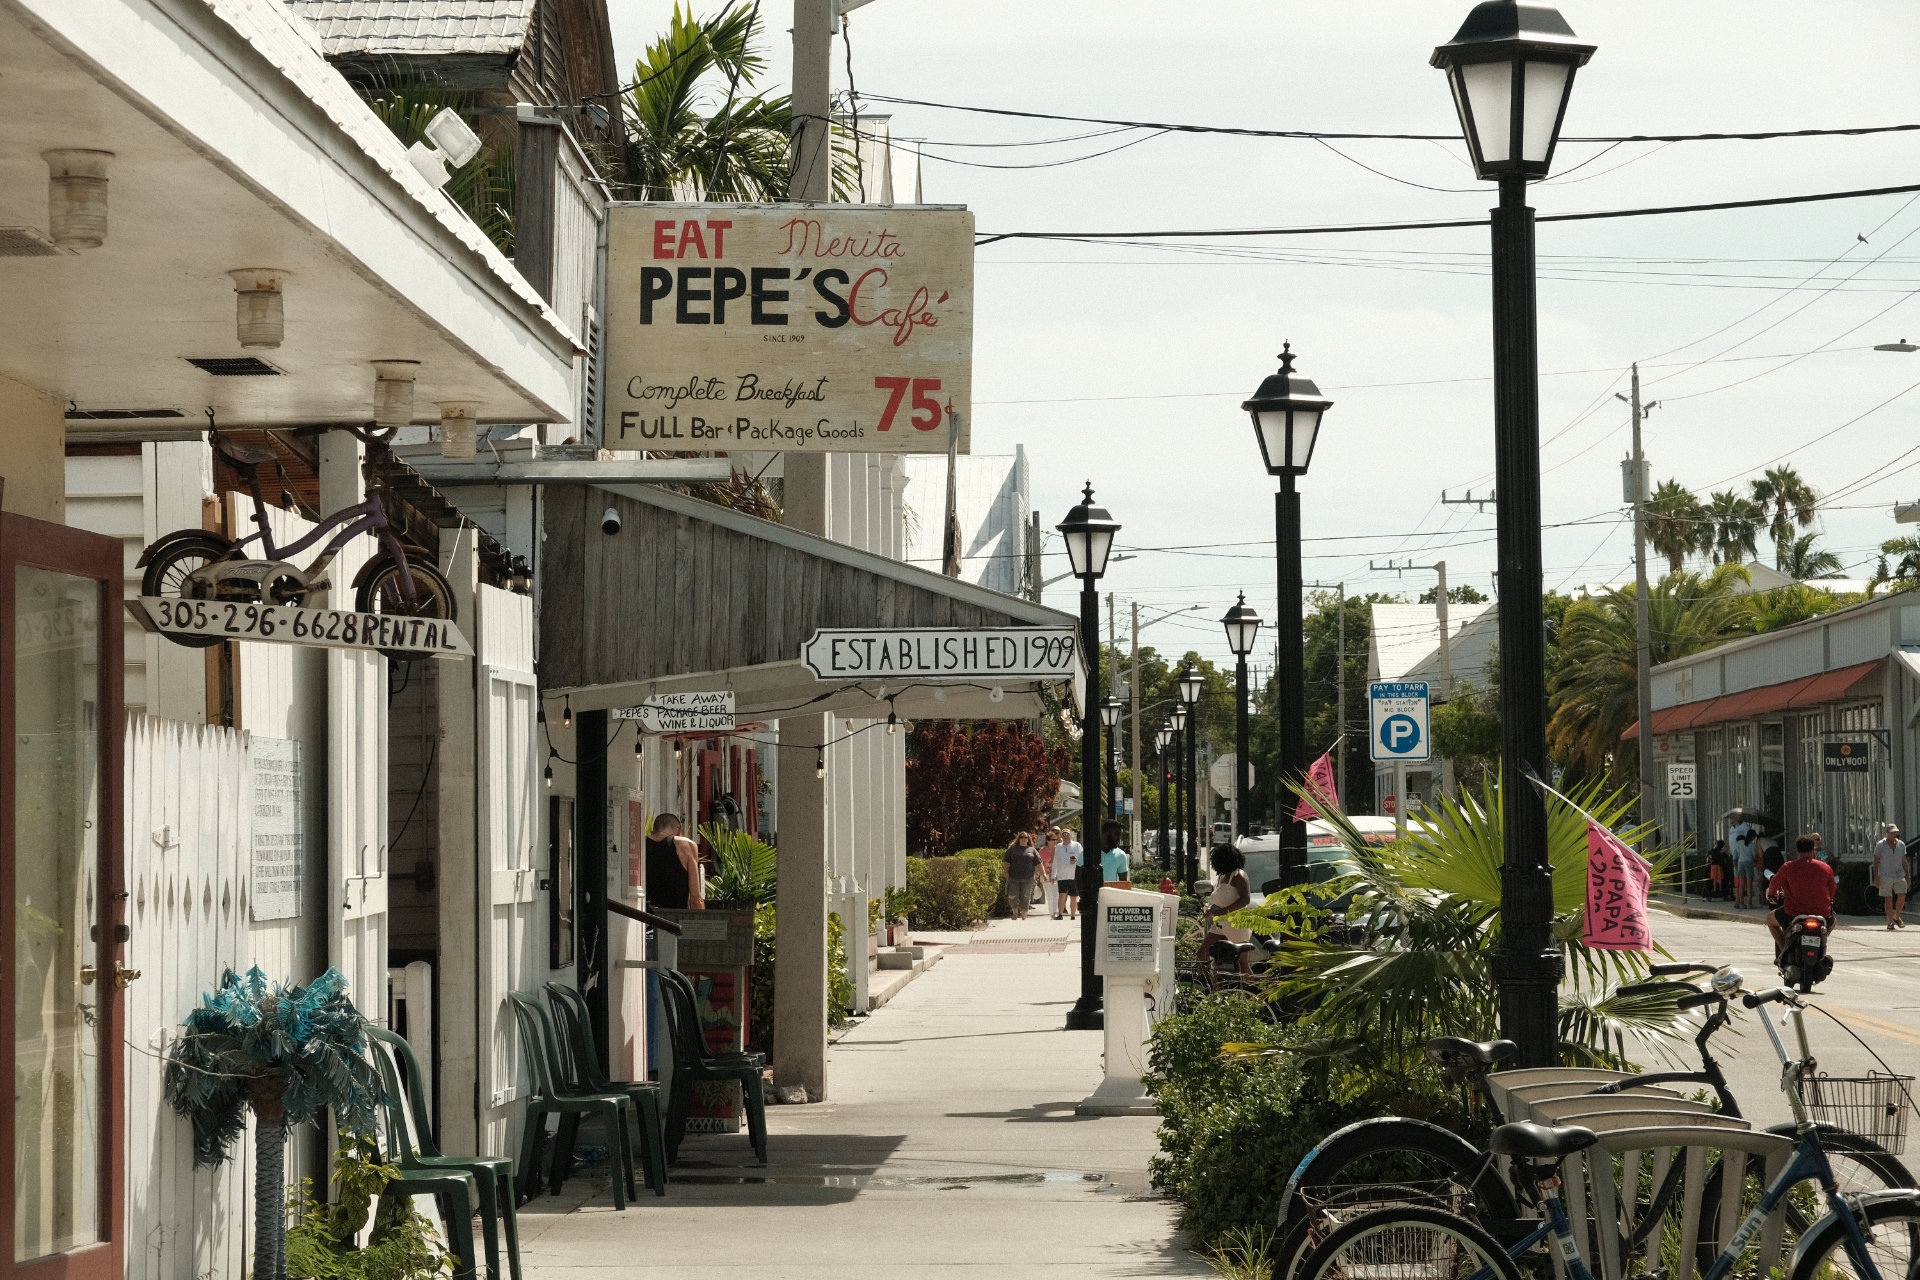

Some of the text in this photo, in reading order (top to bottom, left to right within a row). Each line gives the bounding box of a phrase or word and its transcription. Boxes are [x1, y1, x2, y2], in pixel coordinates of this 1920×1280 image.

[653, 220, 733, 260] EAT
[777, 218, 906, 258] Merita
[639, 266, 850, 328] PEPE'S
[763, 334, 805, 343] SINCE 1909
[626, 373, 830, 409] Complete Breakfast
[620, 411, 684, 440] FULL
[690, 416, 725, 439] Bar
[817, 418, 865, 439] Goods
[361, 613, 458, 651] RENTAL
[831, 635, 1075, 671] ESTABLISHED 1909
[1373, 684, 1389, 692] PAY
[1404, 683, 1425, 691] PARK
[660, 692, 726, 706] TAKE AWAY
[619, 706, 649, 719] PEPE'S
[657, 704, 727, 719] PACKAGE BEER
[658, 714, 734, 730] WINE & LIQUOR
[1390, 720, 1413, 748] P
[1670, 782, 1694, 796] 25
[1384, 800, 1396, 809] STO
[1110, 907, 1140, 915] FLOWER
[1600, 878, 1626, 933] PAPA
